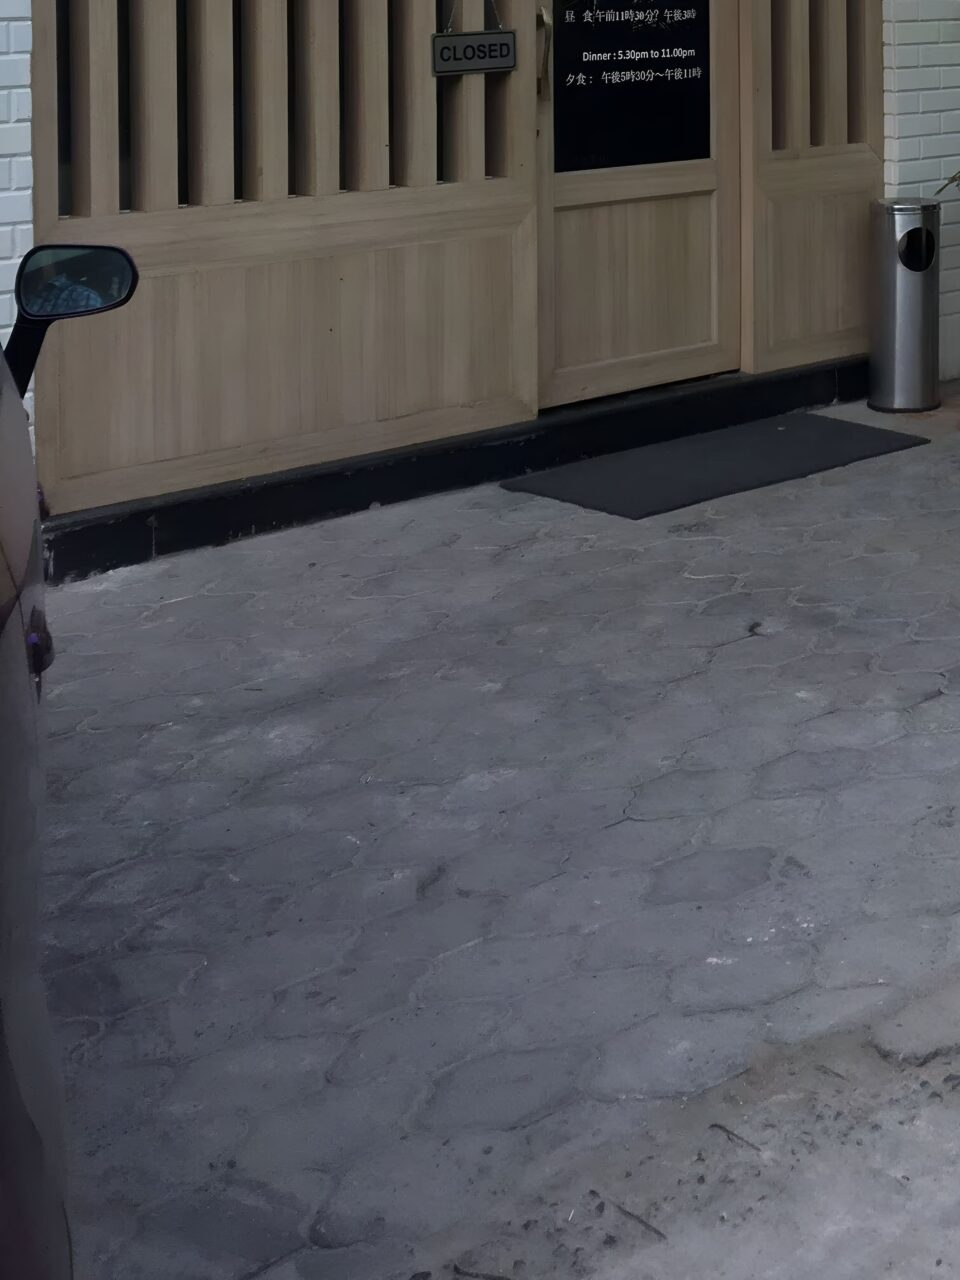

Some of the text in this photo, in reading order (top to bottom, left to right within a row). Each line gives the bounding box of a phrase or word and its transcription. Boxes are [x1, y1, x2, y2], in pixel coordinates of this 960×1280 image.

[440, 43, 511, 62] CLOSED
[582, 51, 611, 61] Dinner
[617, 49, 649, 61] 5.30pm
[650, 49, 659, 59] to
[661, 48, 696, 59] 11.00pm
